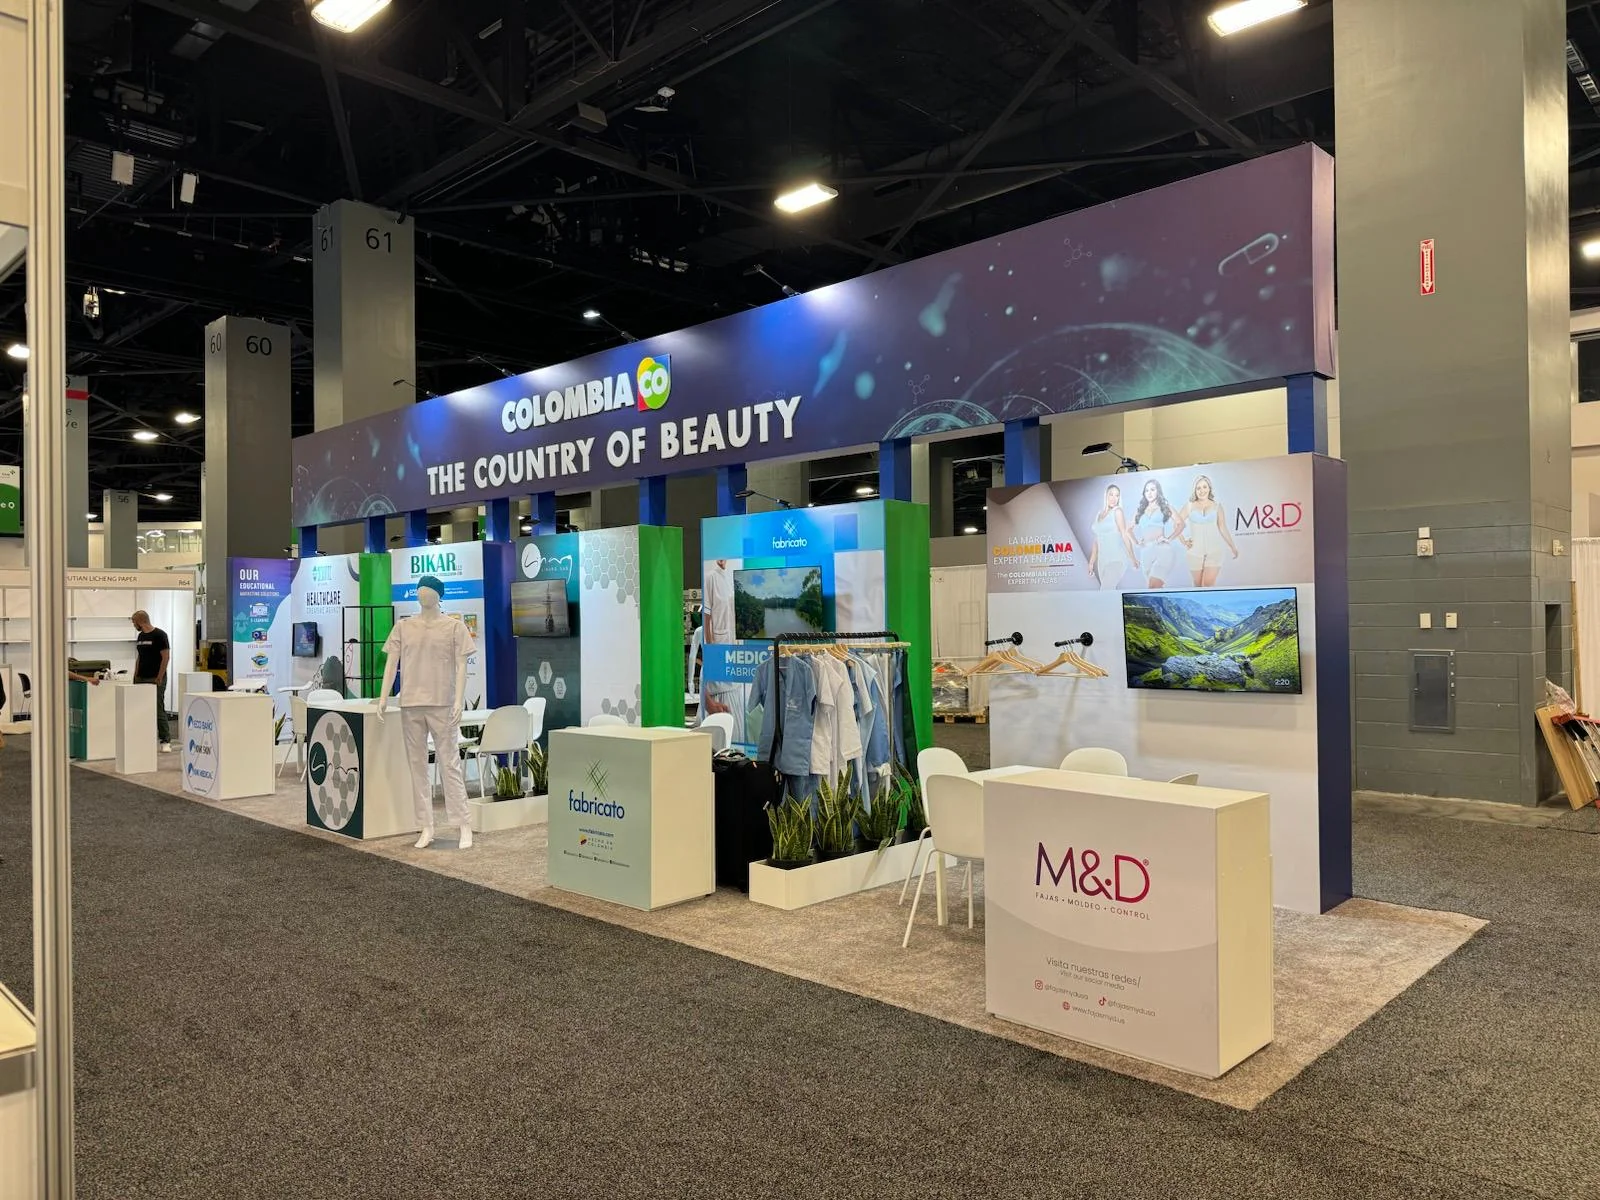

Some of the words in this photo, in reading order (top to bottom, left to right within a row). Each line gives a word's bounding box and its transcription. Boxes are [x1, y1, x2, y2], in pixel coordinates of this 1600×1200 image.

[321, 225, 334, 251] 61
[365, 227, 392, 253] 61
[210, 332, 222, 354] 60
[246, 335, 272, 356] 60
[502, 372, 635, 434] COLOMBIA
[637, 366, 668, 398] CO
[427, 461, 466, 496] THE
[473, 437, 596, 488] COUNTRY
[606, 427, 646, 467] OF
[660, 396, 802, 459] BEAUTY
[772, 537, 808, 550] fabricato
[992, 543, 1073, 556] COLOMBIANA
[1008, 537, 1018, 545] LA
[411, 552, 456, 574] BIKAR
[993, 556, 1029, 566] EXPERTA
[1031, 556, 1043, 564] EN
[240, 568, 259, 581] OUR
[1008, 570, 1047, 578] COLOMBIAN
[240, 582, 276, 590] EDUCATIONAL
[306, 590, 341, 606] HEALTHCARE
[725, 650, 774, 665] MEDIC
[1274, 678, 1290, 686] 2:20
[568, 789, 625, 819] fabricato
[1035, 891, 1059, 903] FAJAS
[1067, 898, 1101, 911] MOLDEO
[1110, 906, 1151, 920] CONTROL
[1046, 957, 1069, 970] Visita
[1070, 964, 1109, 980] nuestras
